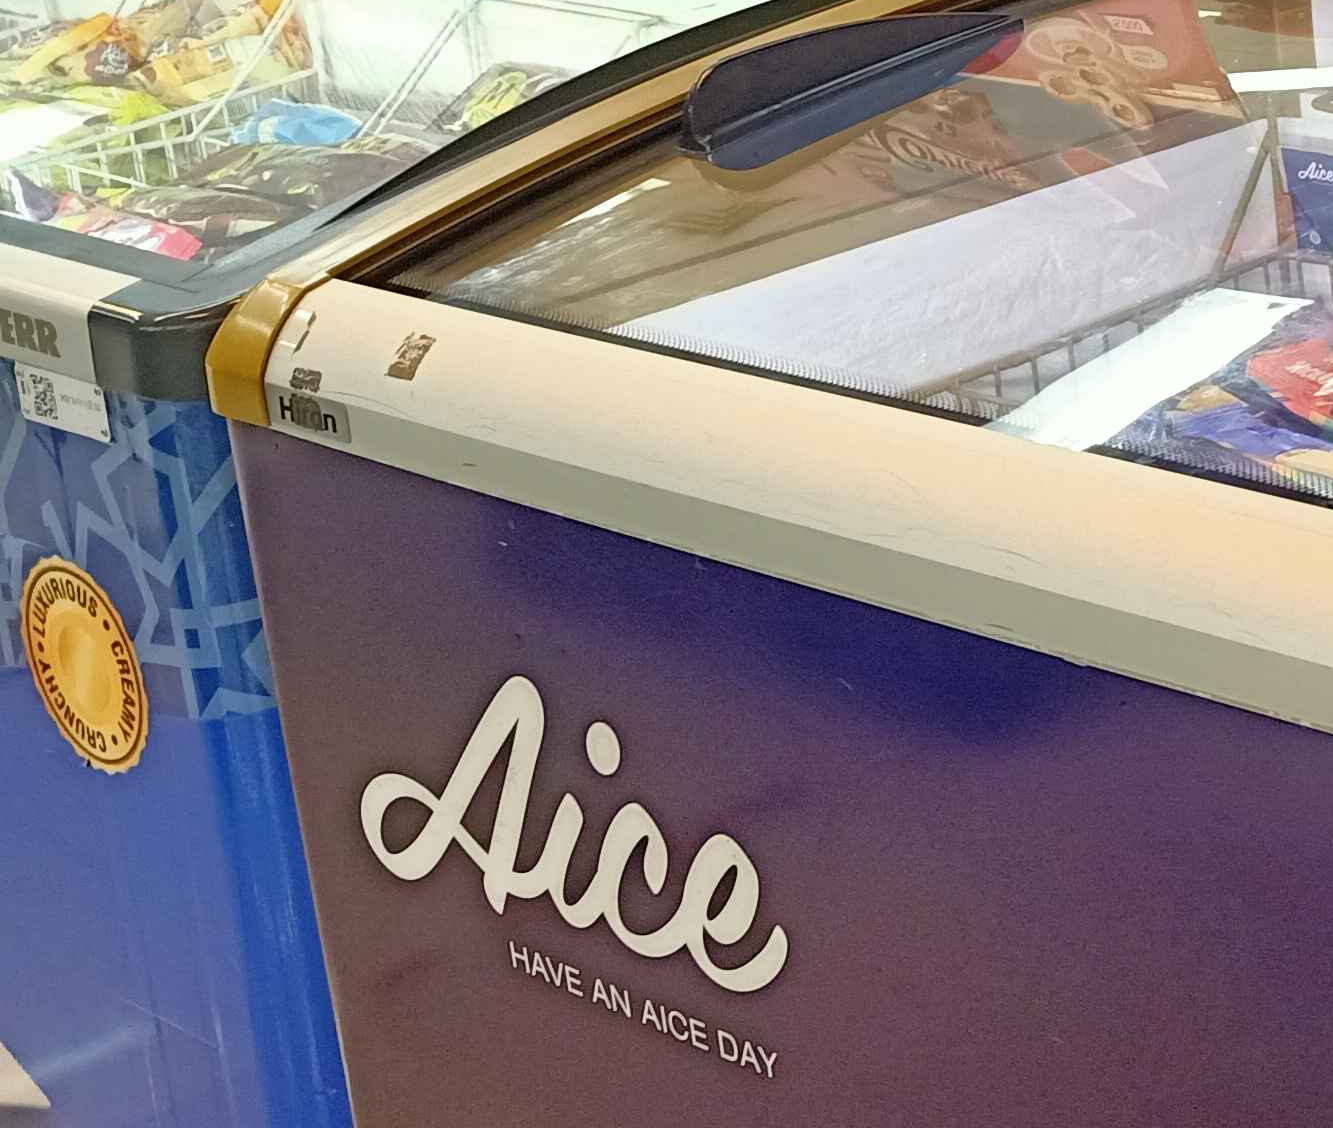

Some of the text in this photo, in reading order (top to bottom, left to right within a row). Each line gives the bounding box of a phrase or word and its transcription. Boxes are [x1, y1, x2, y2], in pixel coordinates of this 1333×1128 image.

[32, 576, 98, 639] LUXURIOUS
[37, 658, 108, 754] CRUNCHY
[110, 639, 137, 744] CREAMY
[360, 675, 789, 992] Aice
[508, 940, 779, 1080] HAVE AN AICE DAY
